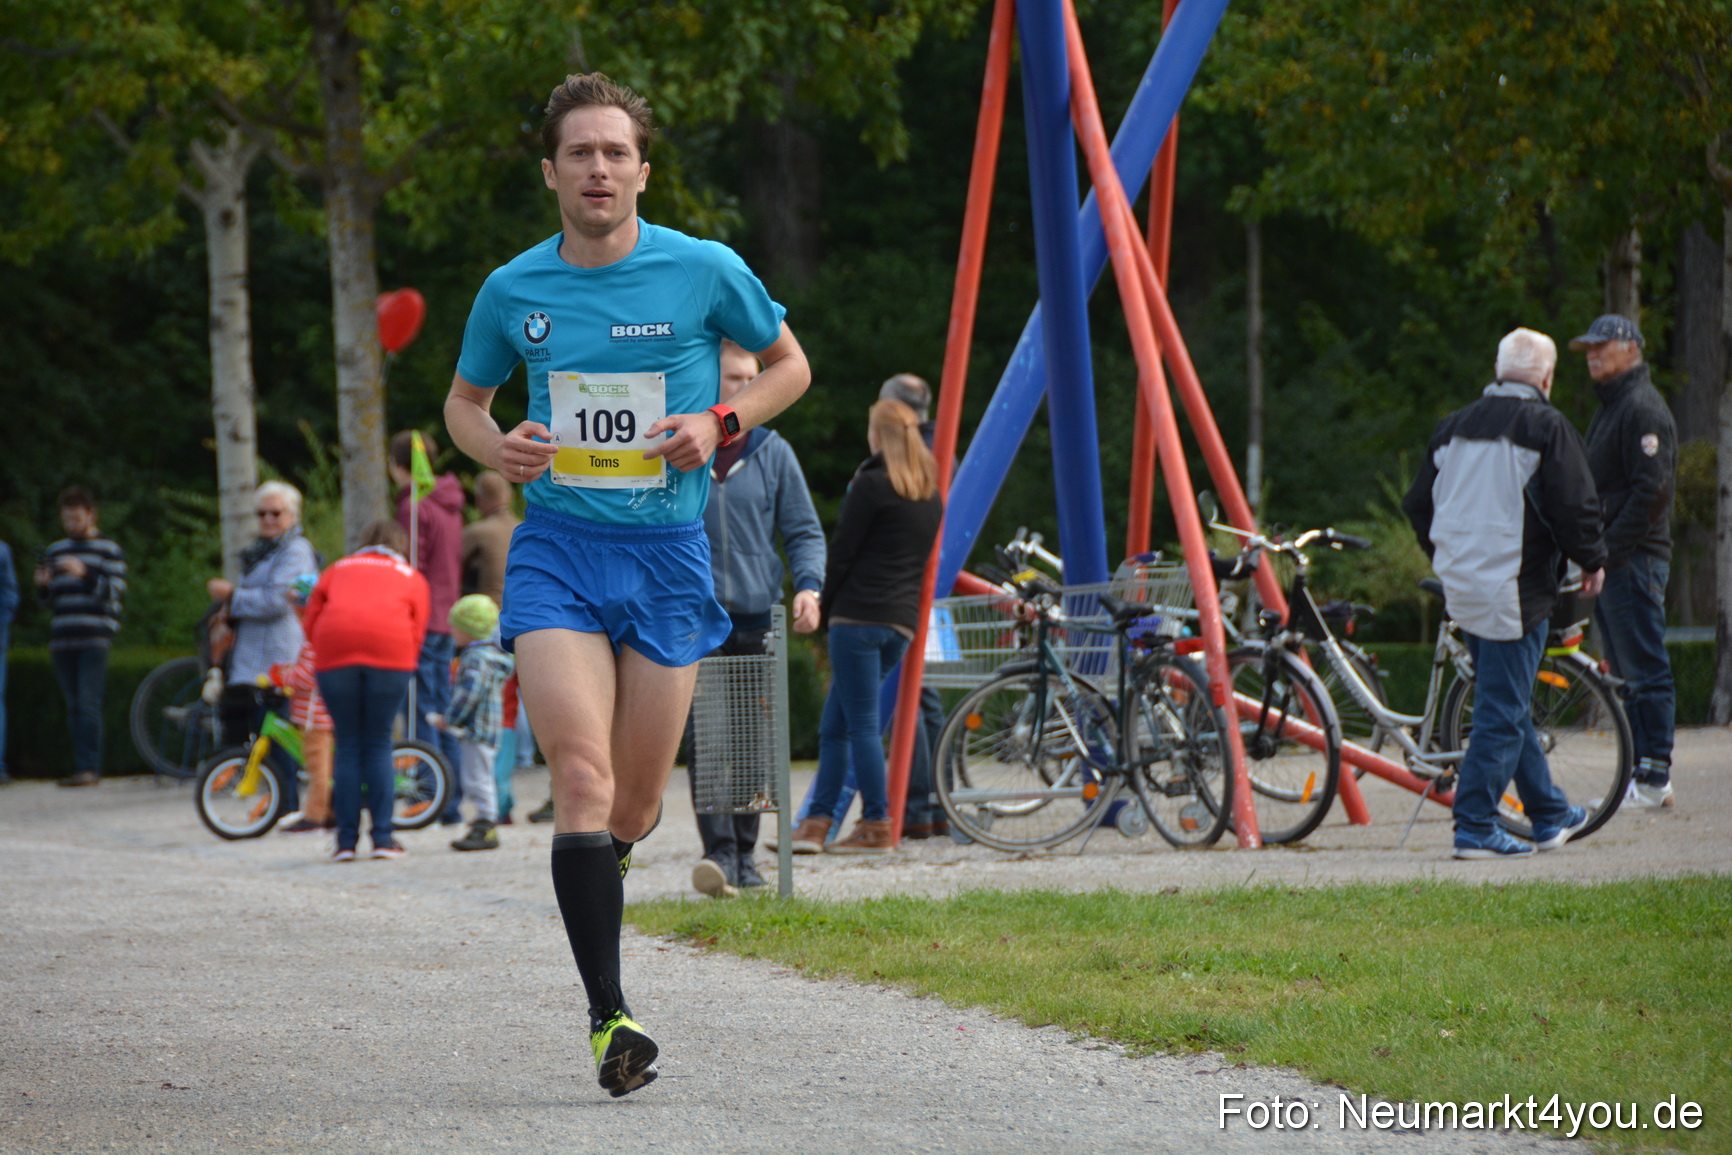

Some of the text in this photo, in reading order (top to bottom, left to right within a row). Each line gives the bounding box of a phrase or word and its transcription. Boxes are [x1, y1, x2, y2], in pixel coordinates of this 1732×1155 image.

[525, 312, 549, 323] BMW
[611, 323, 674, 337] BOCK
[525, 347, 551, 358] PARTL
[588, 384, 629, 394] BOCK
[575, 408, 636, 443] 109
[589, 455, 619, 468] Toms
